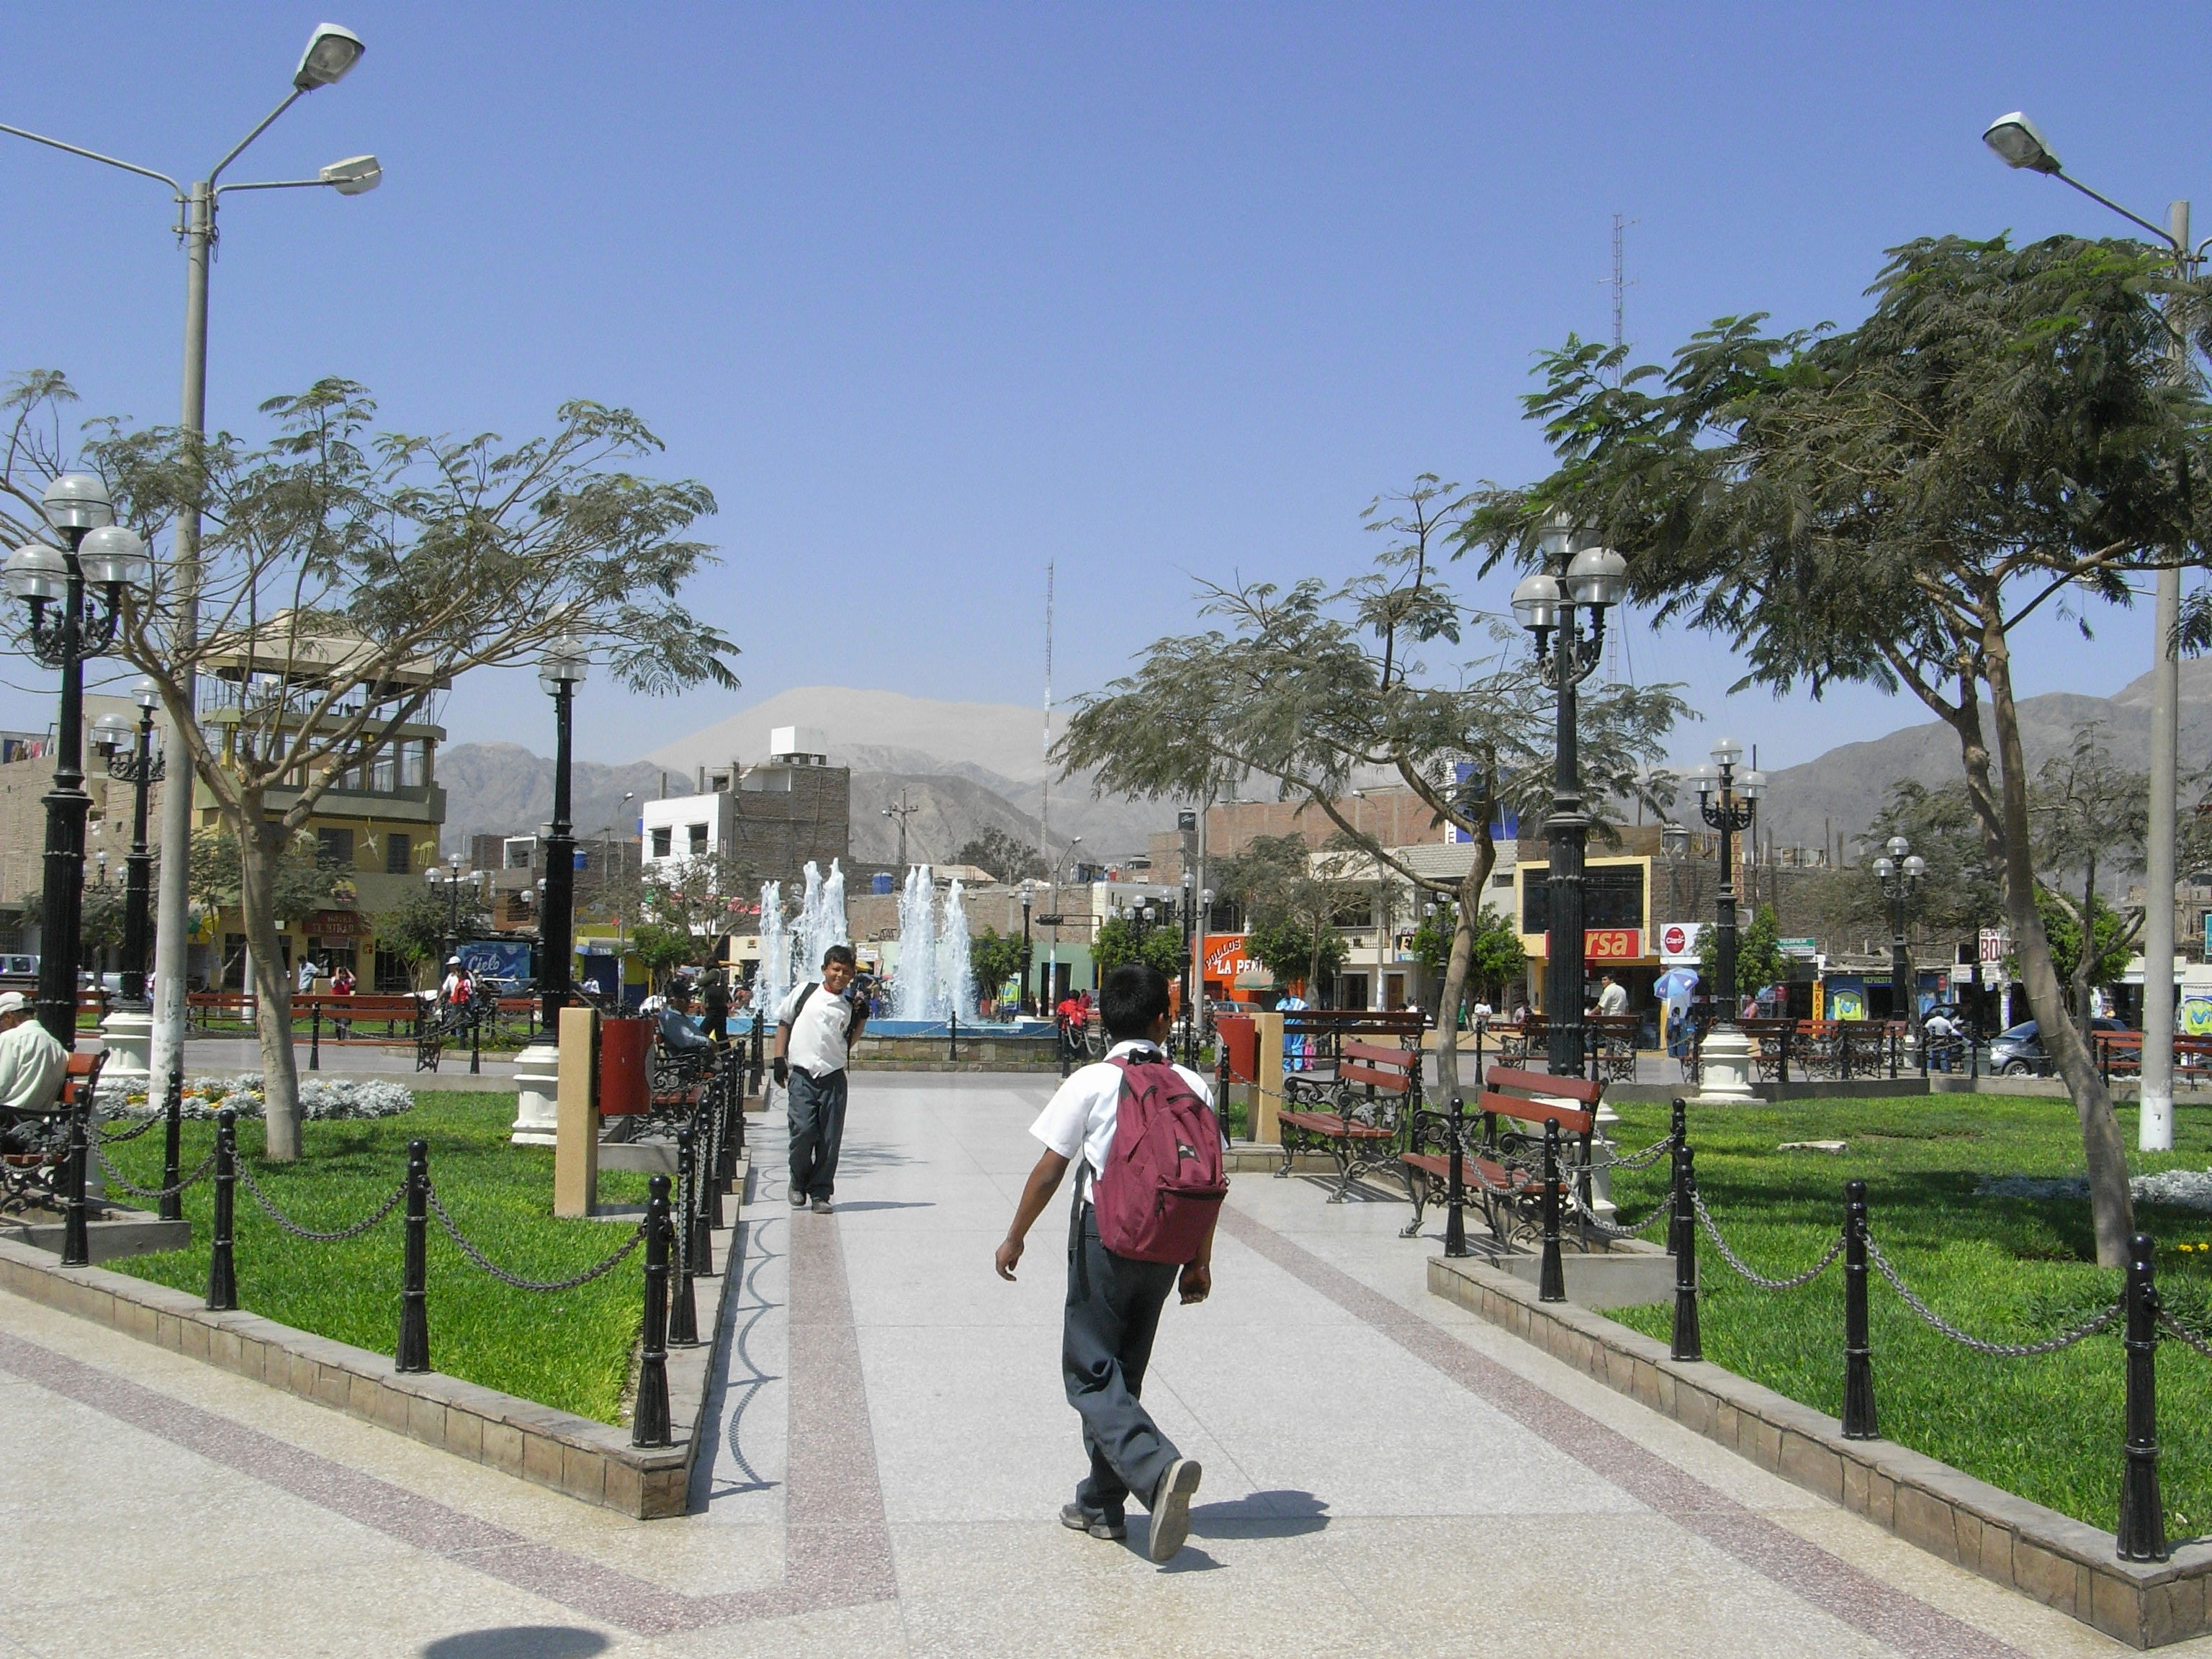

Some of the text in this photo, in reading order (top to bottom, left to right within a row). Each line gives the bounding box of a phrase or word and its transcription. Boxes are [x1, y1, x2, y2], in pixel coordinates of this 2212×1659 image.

[1665, 934, 1683, 945] Claro
[468, 953, 500, 972] Cielo
[1205, 938, 1241, 971] POLLOS
[1217, 957, 1267, 974] LA PEÑ
